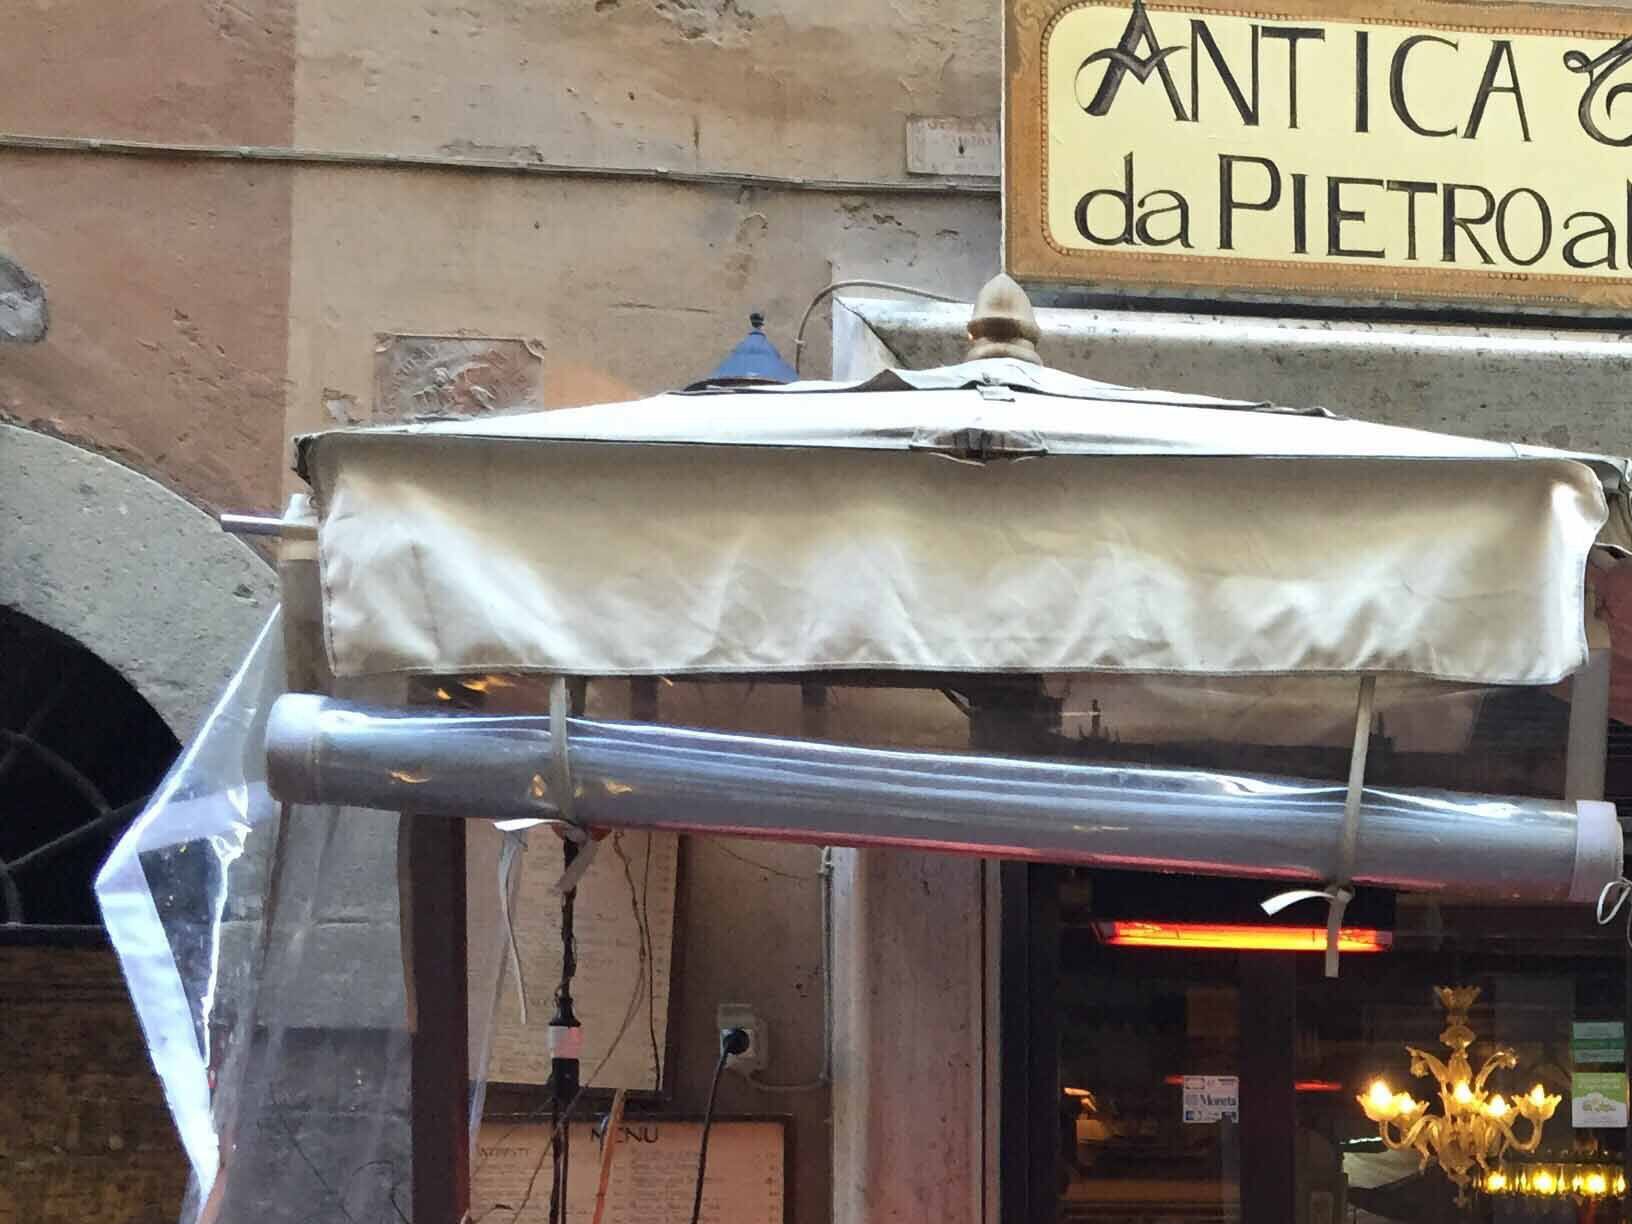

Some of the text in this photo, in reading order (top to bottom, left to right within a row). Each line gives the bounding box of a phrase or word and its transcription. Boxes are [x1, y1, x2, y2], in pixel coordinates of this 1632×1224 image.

[1074, 1, 1532, 143] ANTICA
[1074, 152, 1195, 250] da
[1217, 154, 1553, 266] PIETRO
